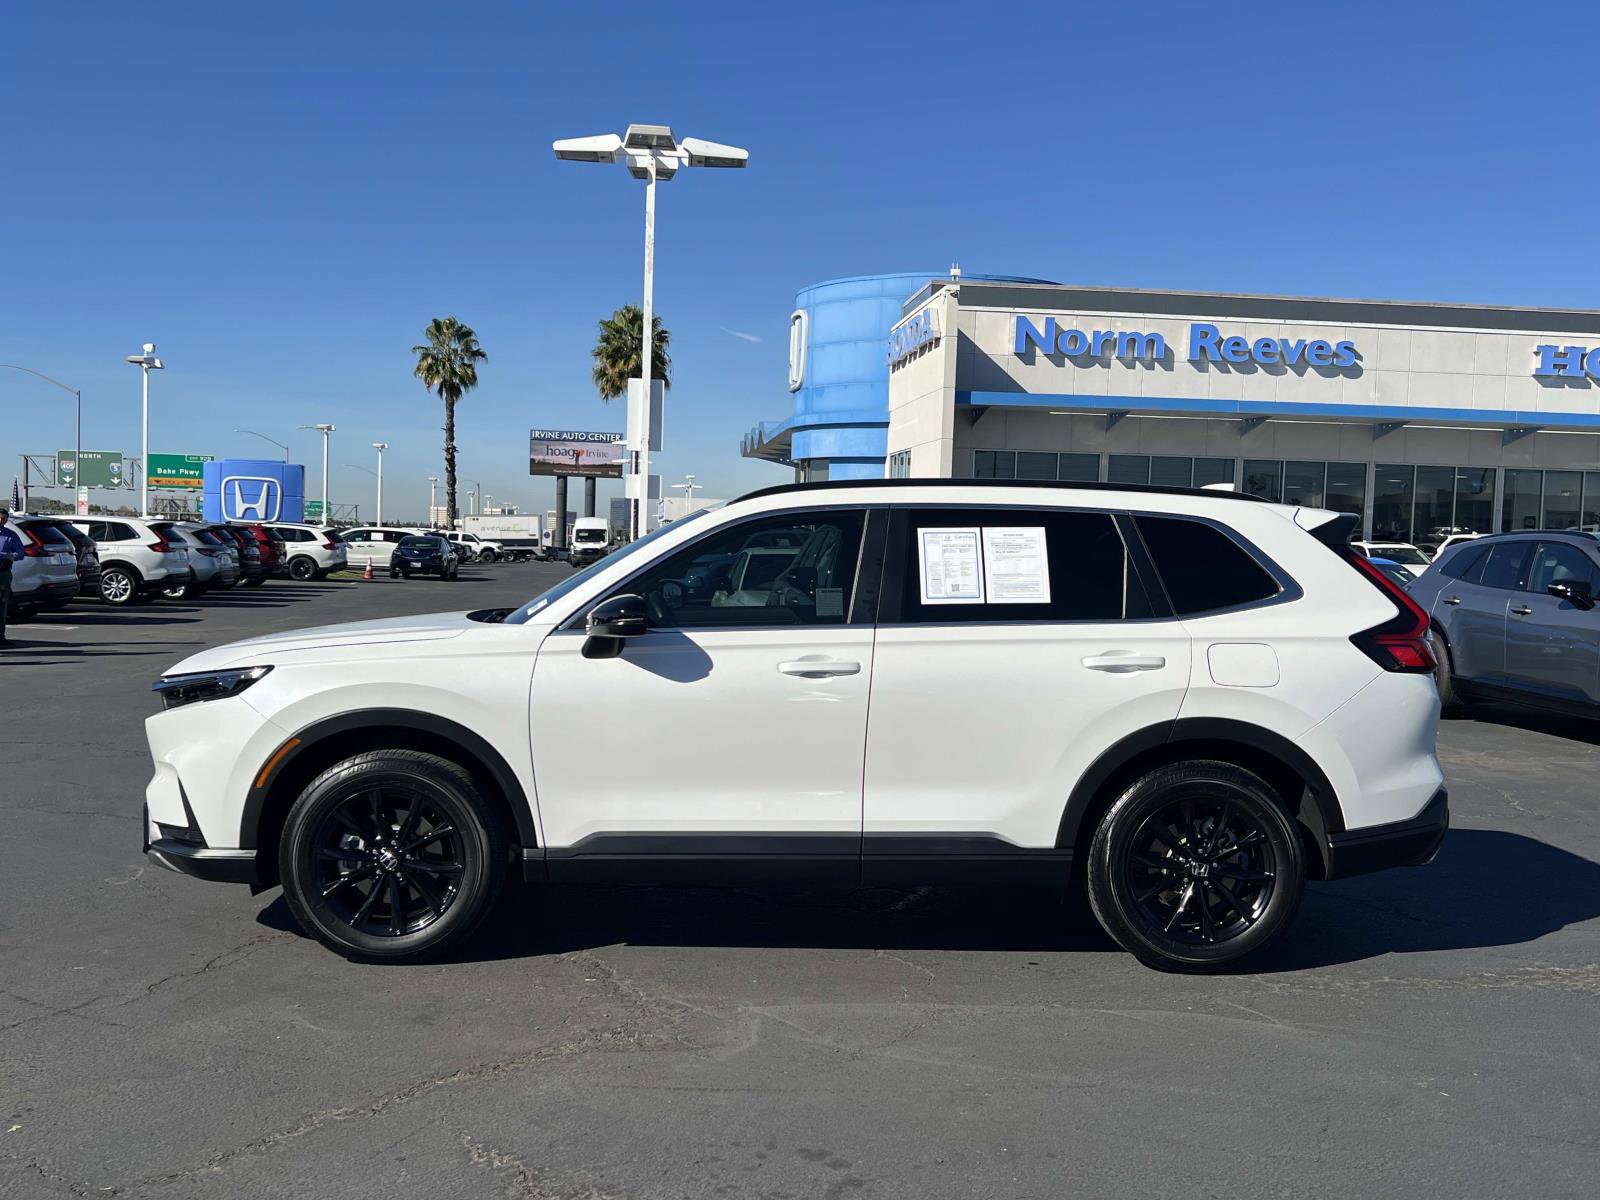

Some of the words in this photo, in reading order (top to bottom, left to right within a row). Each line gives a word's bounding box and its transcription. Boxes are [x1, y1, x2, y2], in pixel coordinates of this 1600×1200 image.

[1014, 315, 1165, 360] Norm
[1187, 322, 1357, 368] Reeves
[532, 430, 560, 440] IRVINE
[562, 433, 586, 441] AUTO
[588, 433, 621, 442] CENTER
[546, 445, 576, 460] hoag
[586, 448, 608, 459] Irvine
[156, 467, 176, 475] Bake
[179, 468, 200, 477] Pkwy
